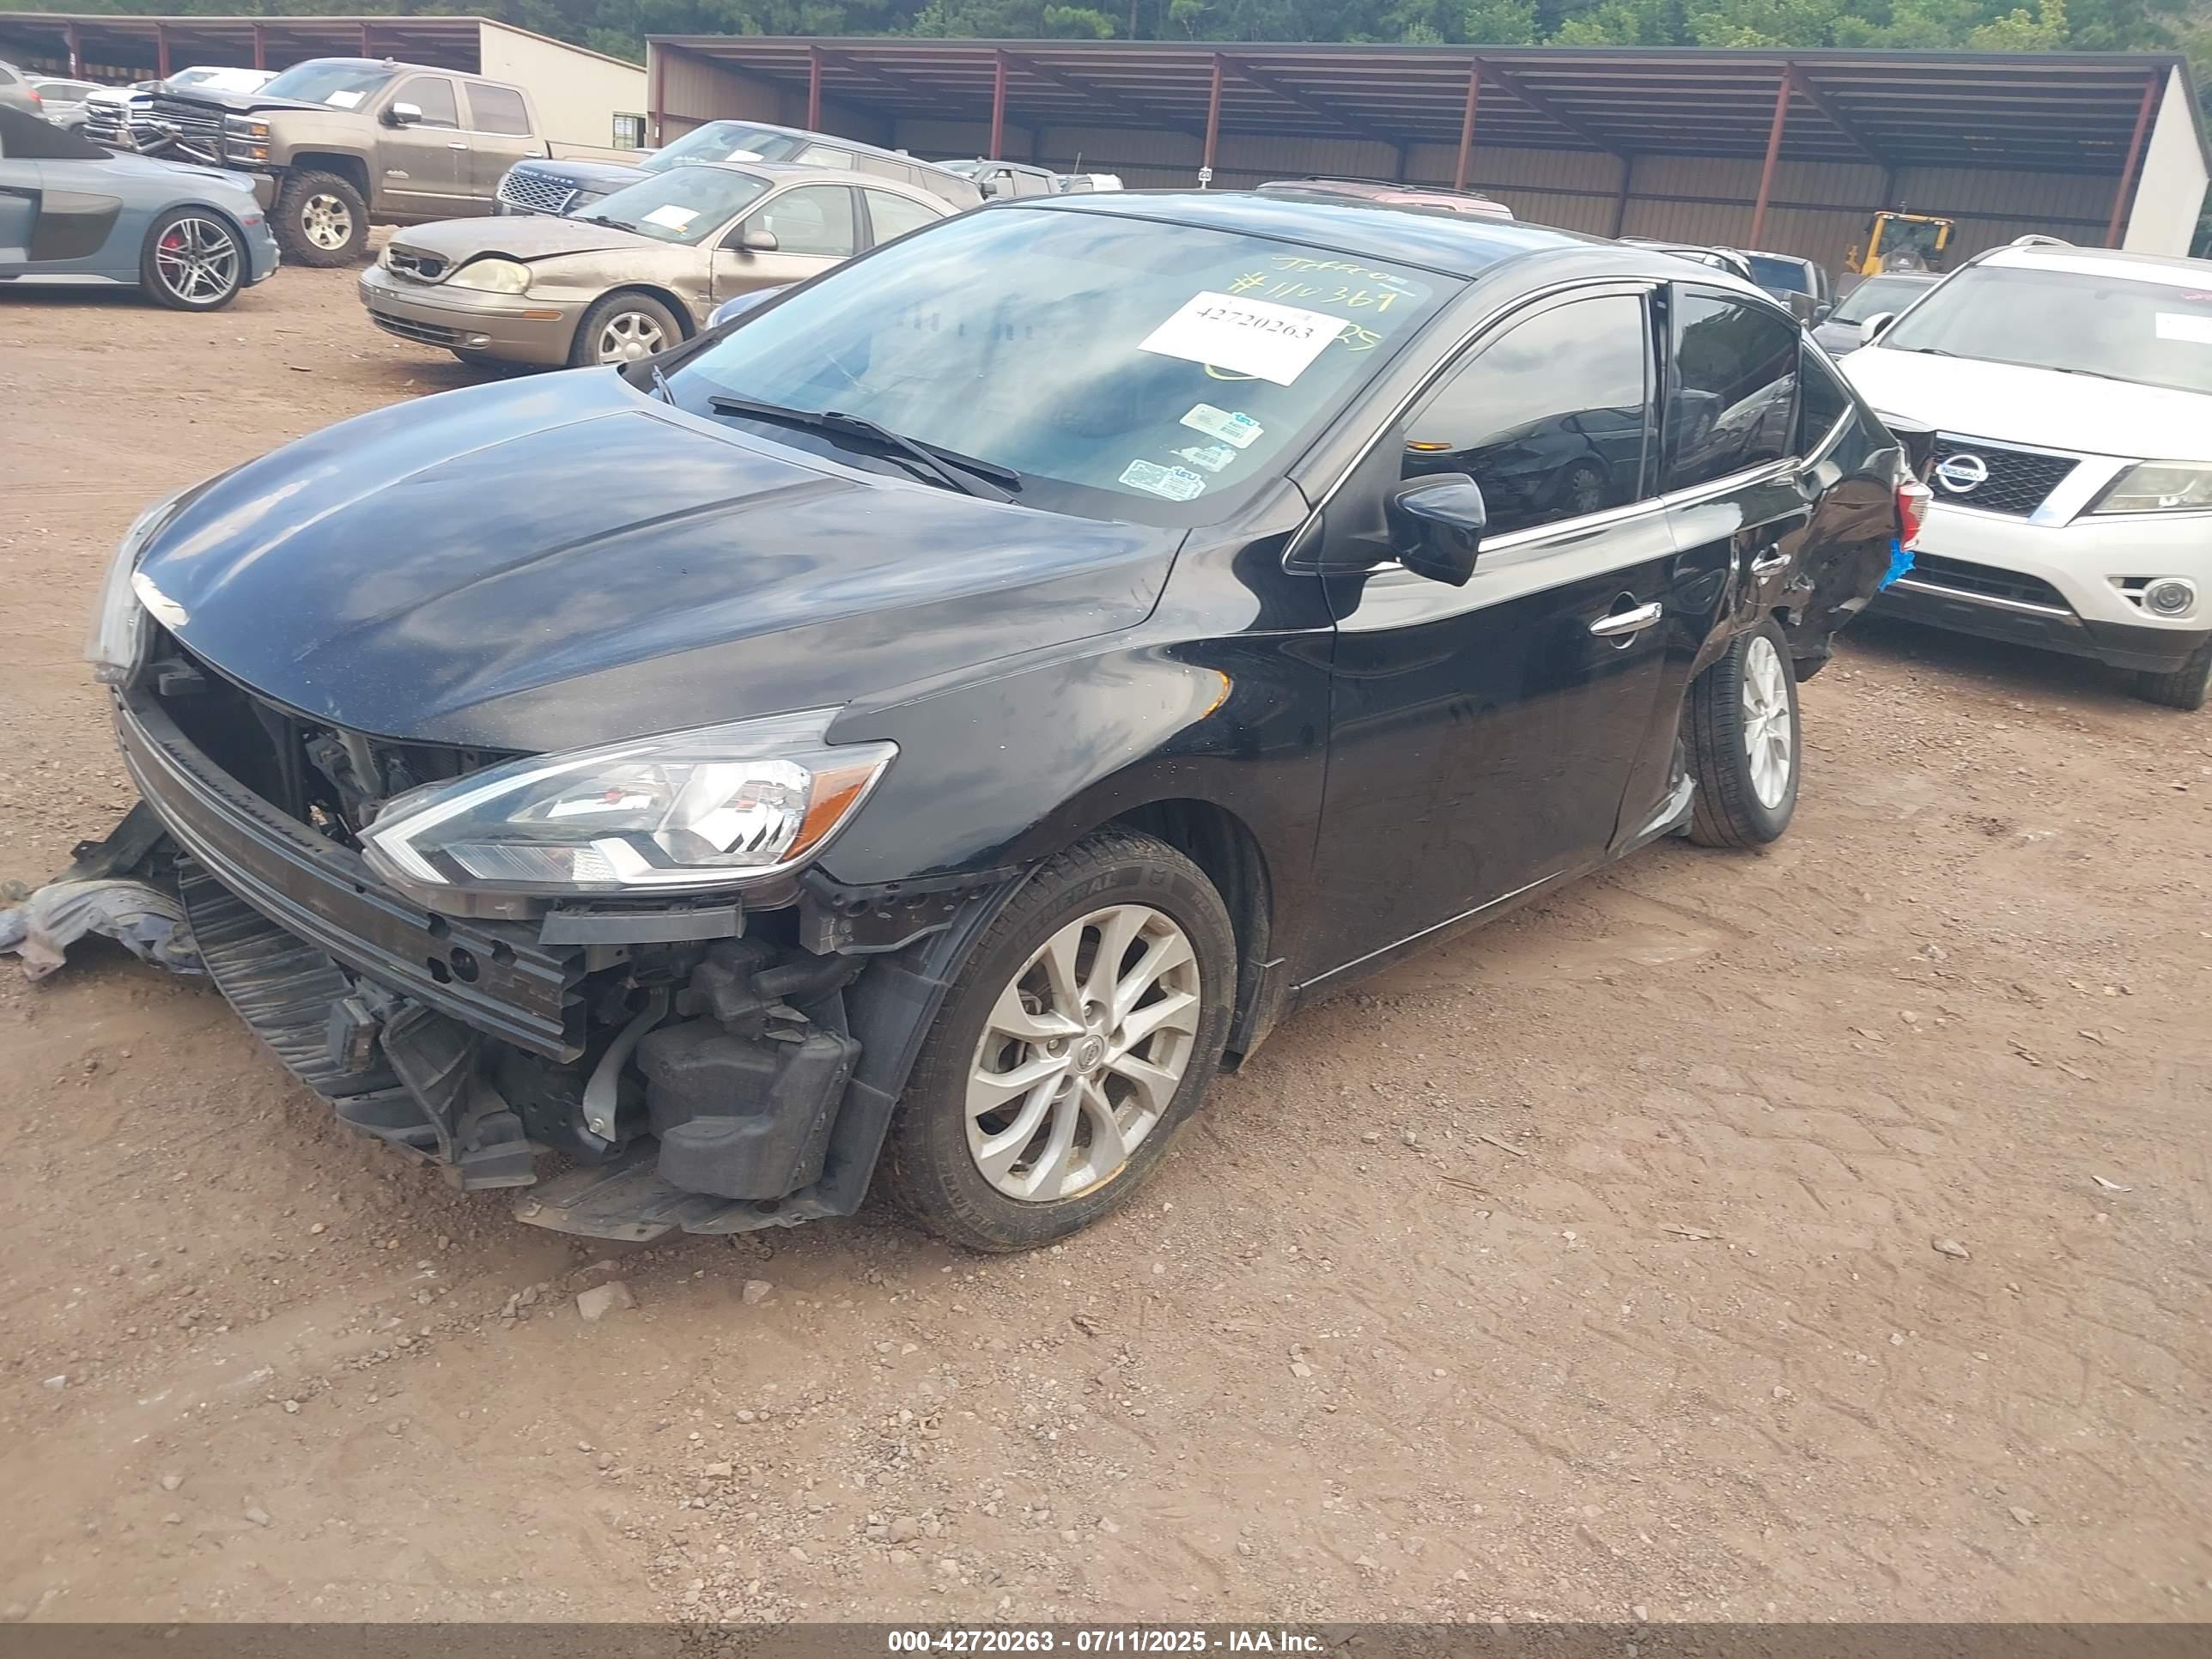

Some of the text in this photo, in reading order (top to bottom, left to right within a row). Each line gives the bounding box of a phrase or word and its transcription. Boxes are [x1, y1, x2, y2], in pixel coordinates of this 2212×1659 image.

[541, 174, 574, 185] ROVER
[1196, 307, 1314, 340] 42720263
[1942, 465, 1982, 479] NISSAN
